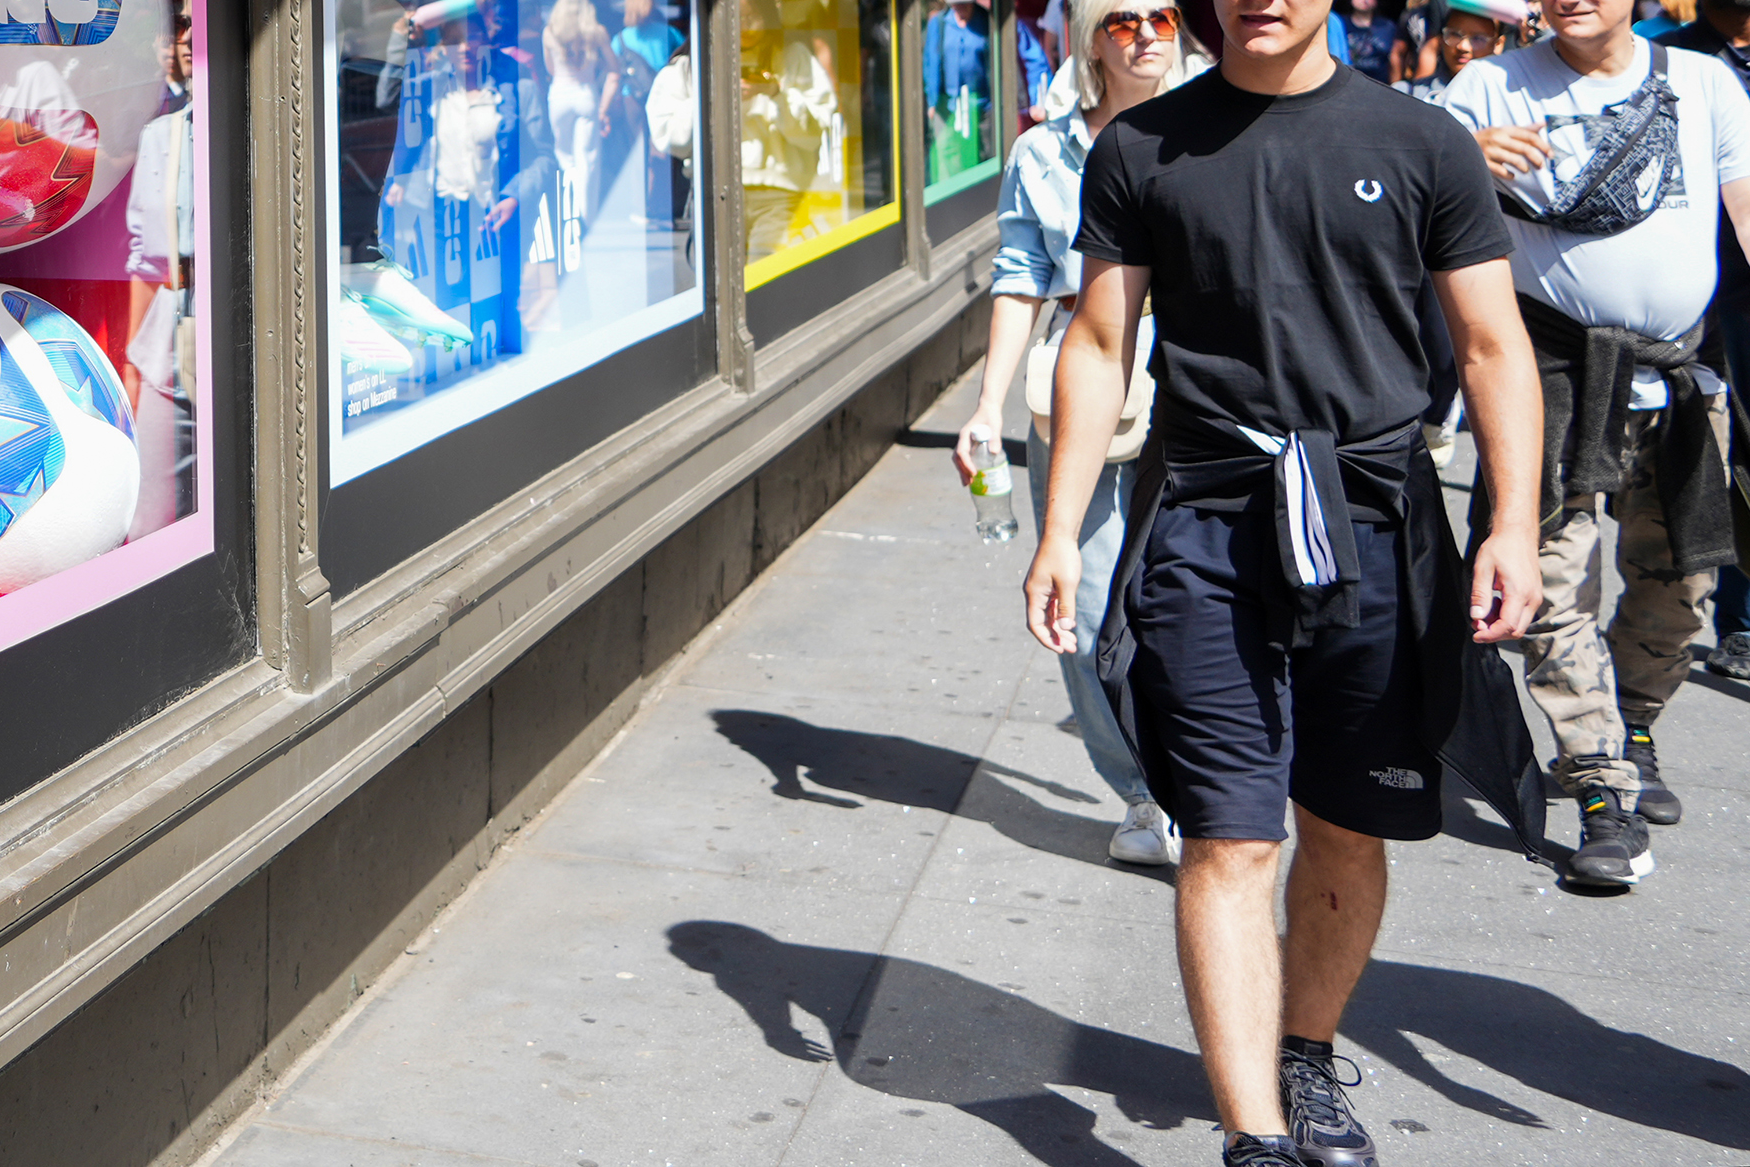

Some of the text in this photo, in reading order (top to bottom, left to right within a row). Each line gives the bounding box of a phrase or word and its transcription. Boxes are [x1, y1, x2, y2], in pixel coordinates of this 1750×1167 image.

[371, 374, 378, 387] on
[347, 386, 397, 417] shop on Mezzanine
[1369, 770, 1406, 782] NORTH
[1386, 766, 1407, 776] THE
[1379, 777, 1406, 789] FACE
